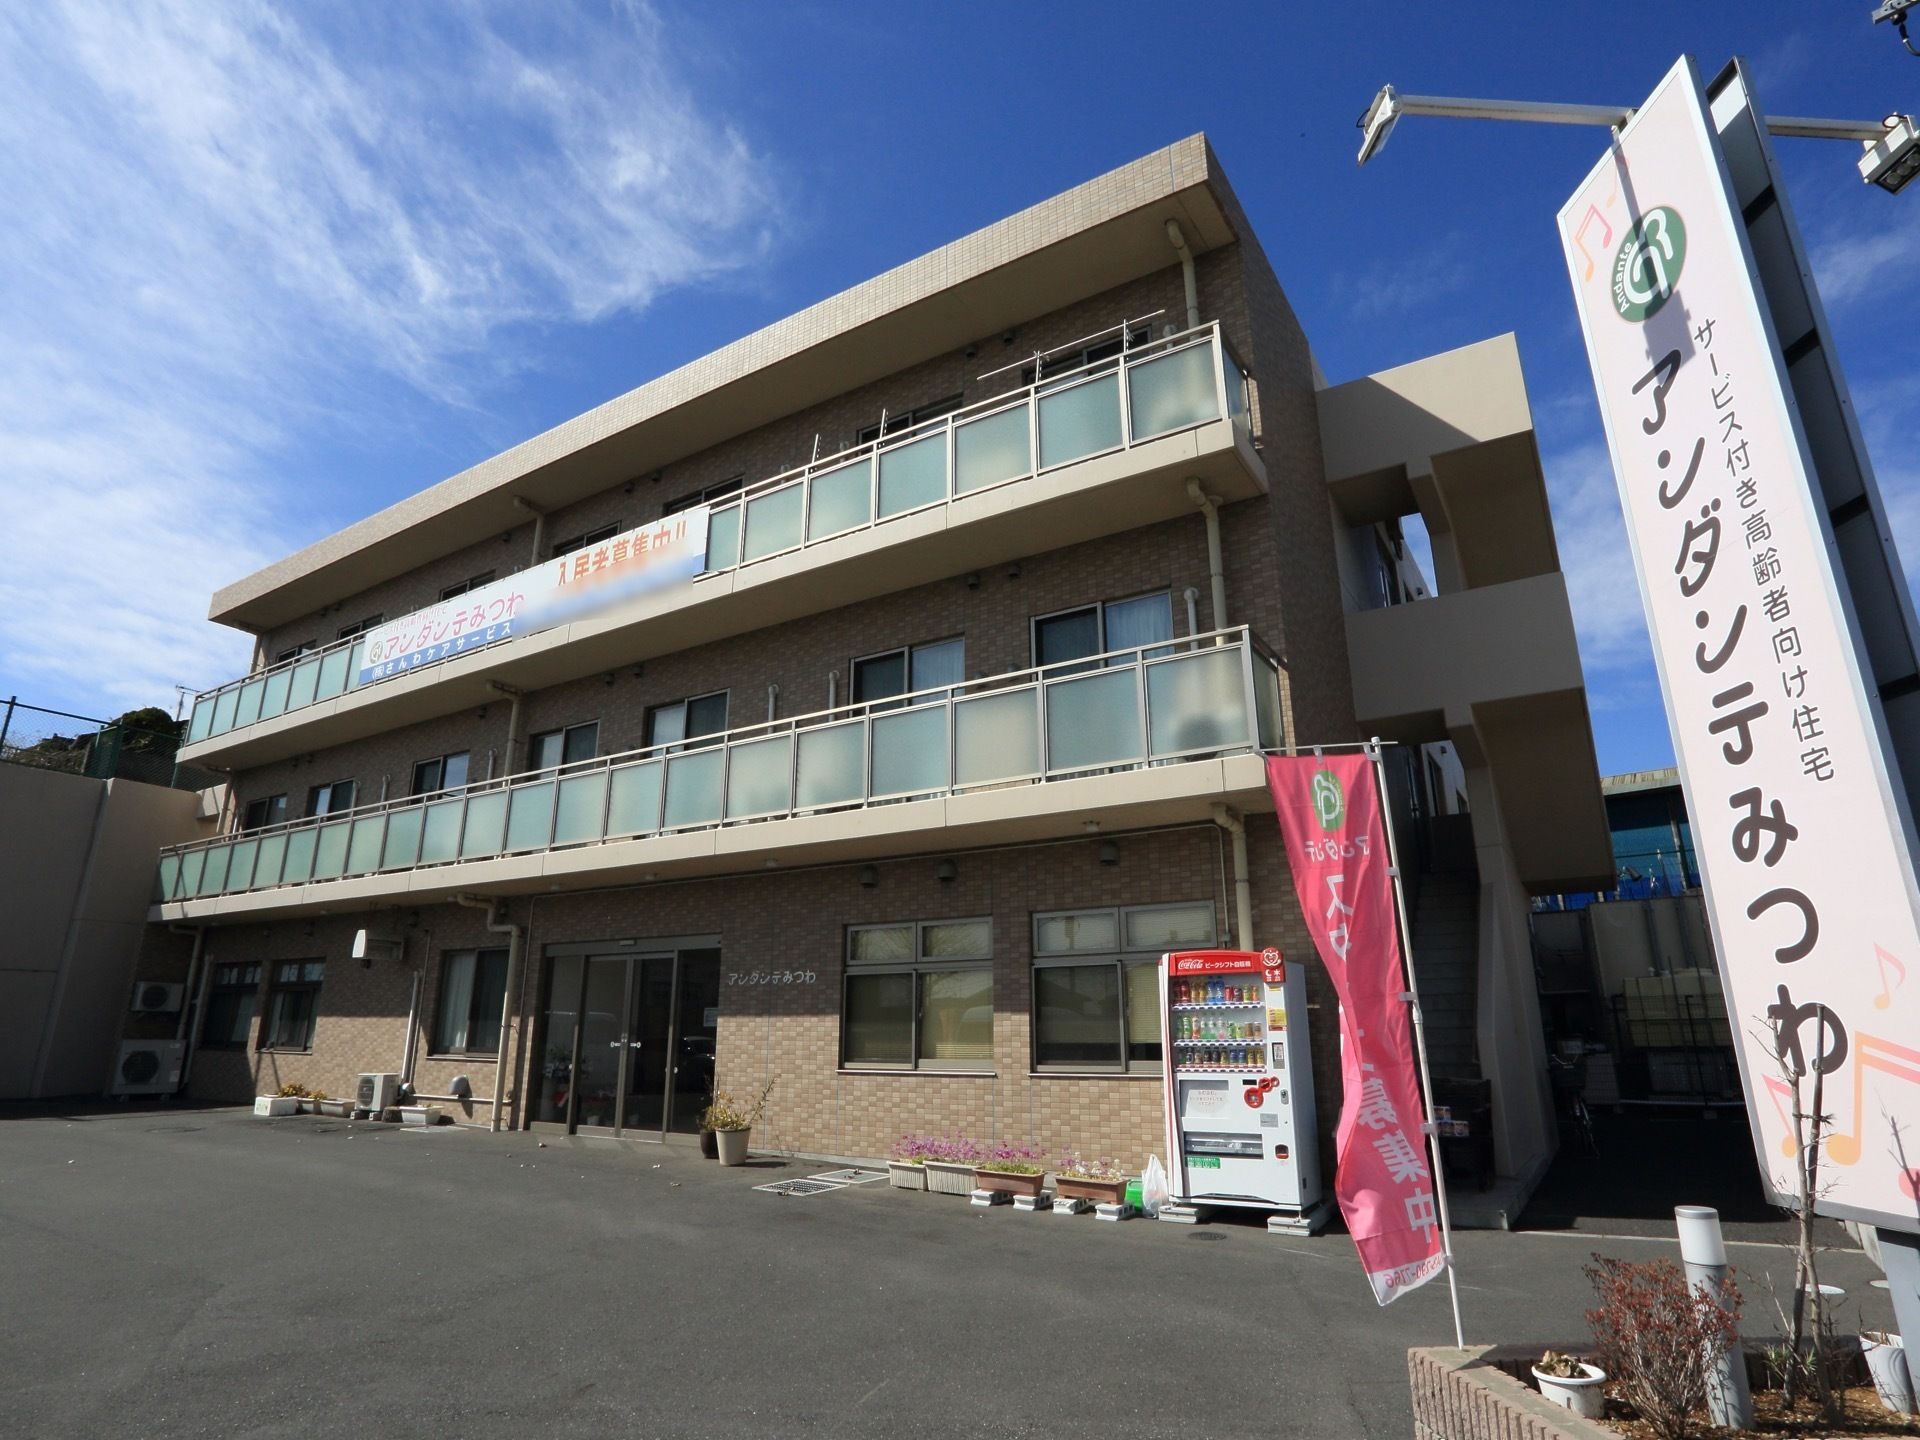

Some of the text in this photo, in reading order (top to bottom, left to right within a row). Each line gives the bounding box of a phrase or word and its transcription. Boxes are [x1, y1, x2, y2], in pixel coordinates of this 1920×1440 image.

[1613, 242, 1632, 313] Andante
[1693, 318, 1834, 783] サービス付き高齢者向け住宅
[383, 591, 524, 660] アンダンテみつわ
[1631, 348, 1849, 1077] アンダンテみつわ
[728, 969, 816, 986] アンダンテみつわ
